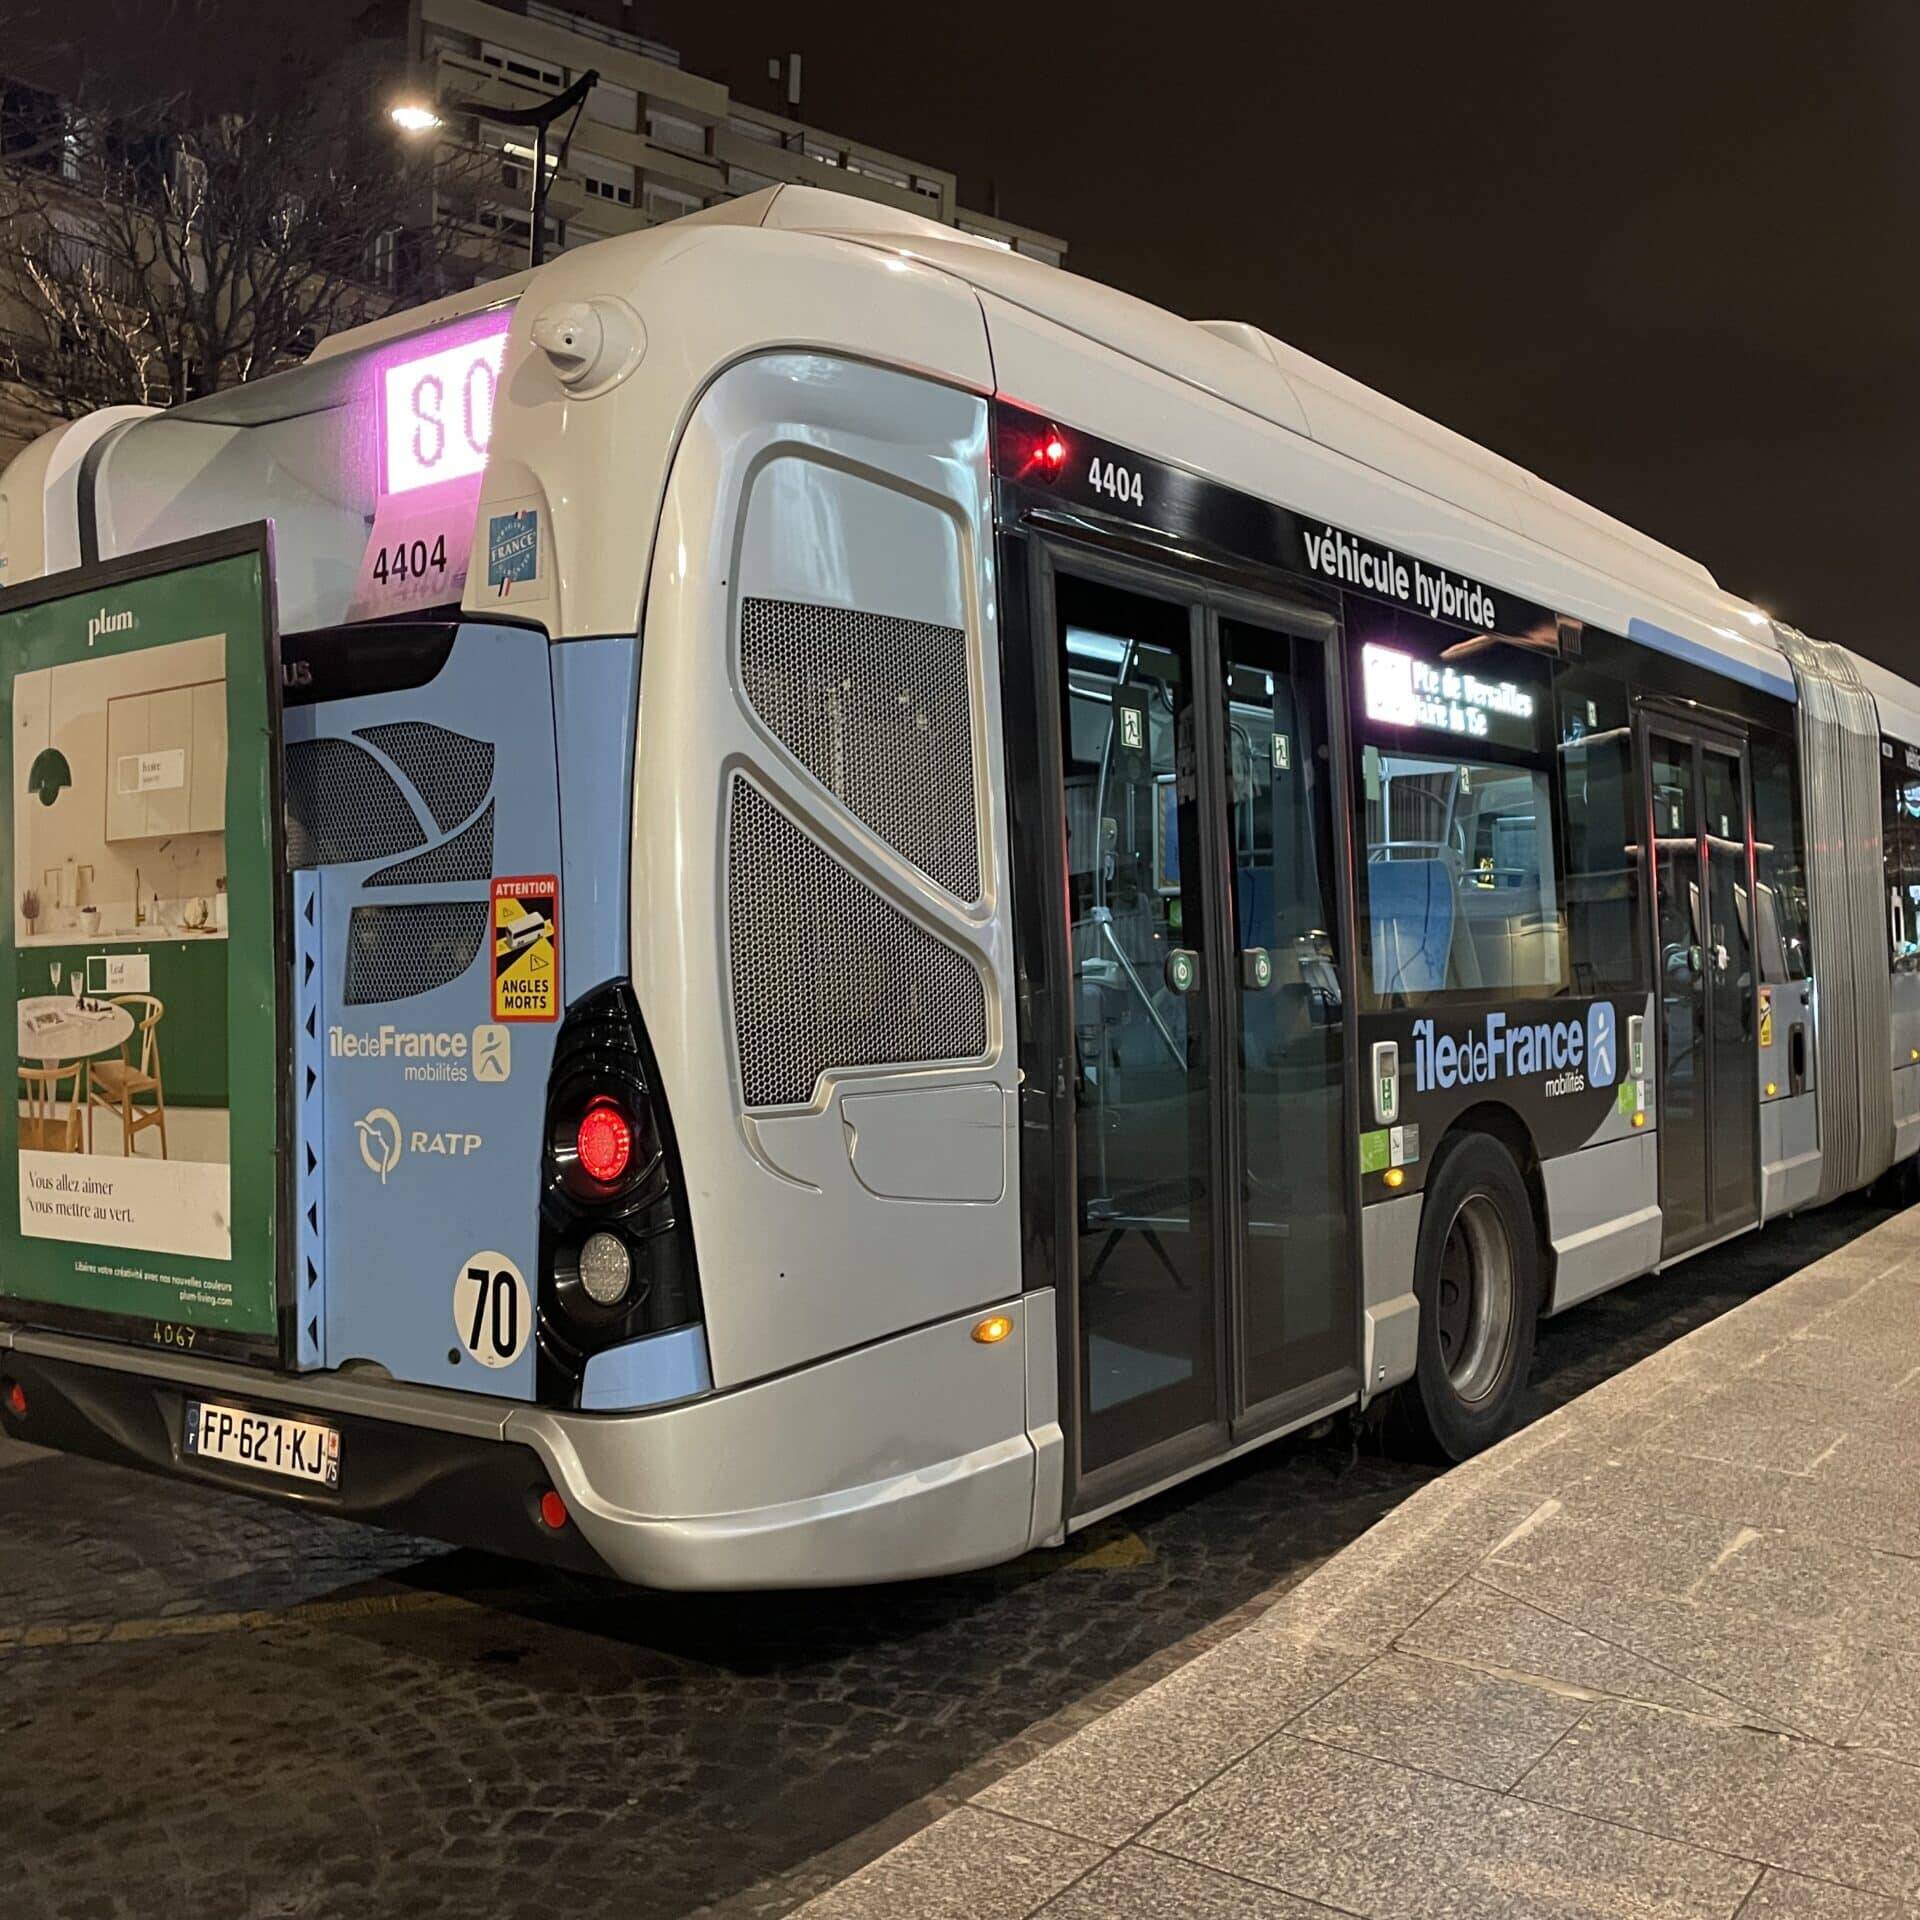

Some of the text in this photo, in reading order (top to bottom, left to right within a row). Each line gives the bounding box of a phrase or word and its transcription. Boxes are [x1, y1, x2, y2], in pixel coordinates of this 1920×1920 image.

[1088, 457, 1144, 507] 4404
[373, 534, 447, 585] 4404
[491, 532, 536, 562] FRANCE
[1304, 526, 1495, 629] véhicule hybride
[88, 607, 133, 646] plum
[282, 660, 312, 686] US
[496, 881, 555, 896] ATTENTION
[502, 979, 549, 993] ANGLES
[504, 996, 547, 1009] MORTS
[404, 1062, 468, 1082] mobilités
[1545, 1068, 1585, 1097] mobilités
[410, 1131, 482, 1156] RATP
[29, 1170, 114, 1196] Vous allez aimer
[55, 1202, 91, 1218] mettre
[93, 1207, 107, 1219] au
[97, 1265, 113, 1276] votre
[144, 1272, 159, 1283] avec
[159, 1274, 171, 1284] nos
[171, 1276, 202, 1289] nouvelles
[203, 1280, 233, 1292] couleurs
[467, 1267, 518, 1359] 70
[153, 1321, 196, 1349] 4067
[188, 1432, 196, 1446] F
[203, 1410, 324, 1475] FP-621-KJ
[326, 1460, 338, 1482] 75
